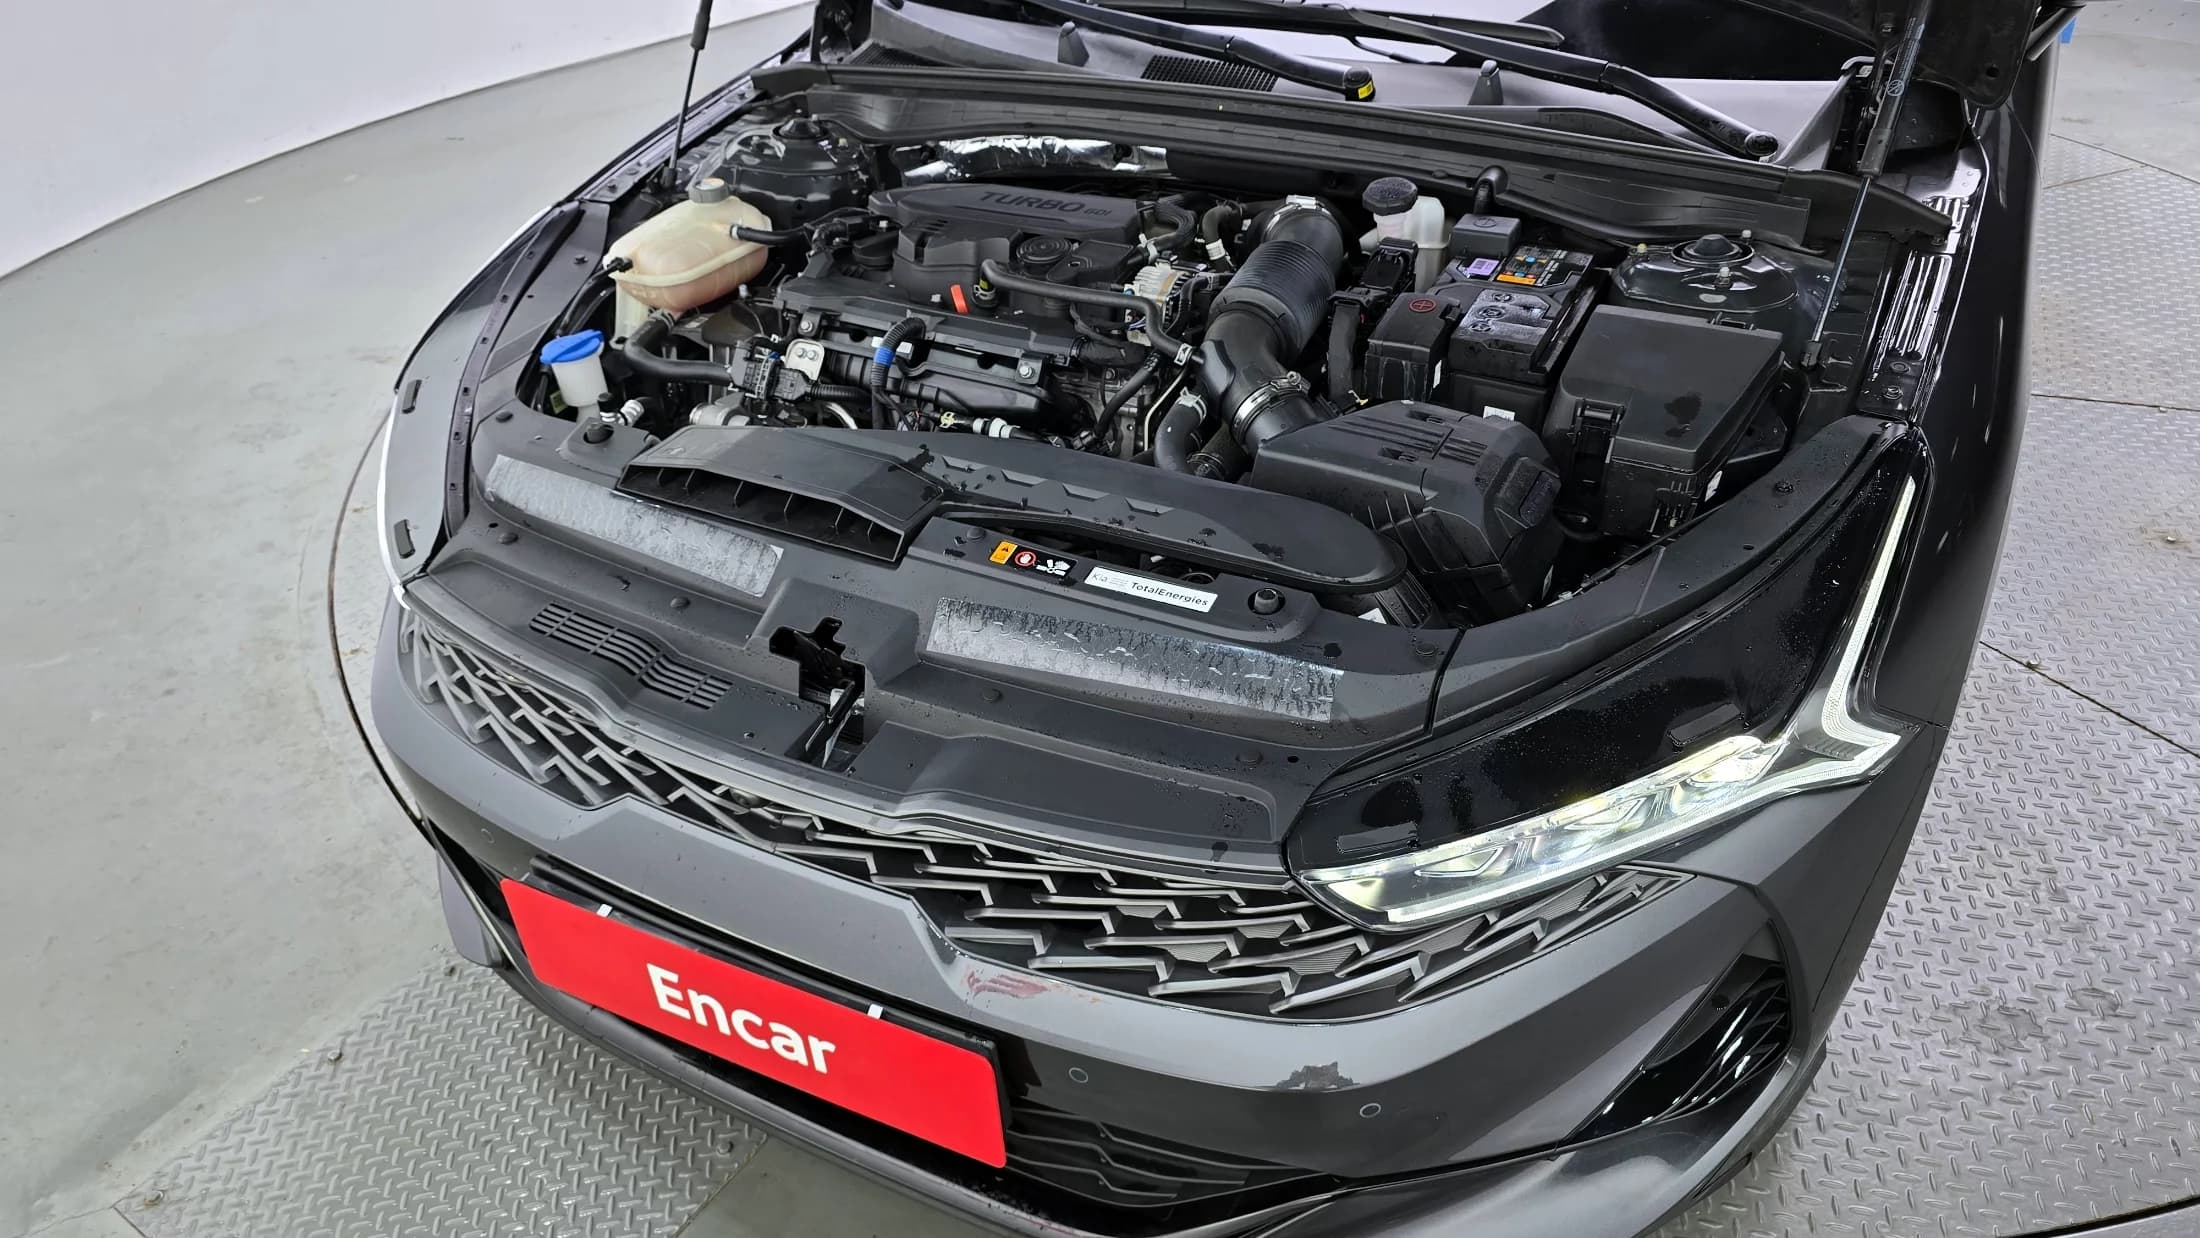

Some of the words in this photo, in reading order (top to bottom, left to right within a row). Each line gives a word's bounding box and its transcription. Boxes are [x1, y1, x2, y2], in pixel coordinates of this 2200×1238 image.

[980, 191, 1086, 212] TURBO
[1131, 581, 1209, 606] TotalEnergies
[646, 963, 836, 1075] Encar
